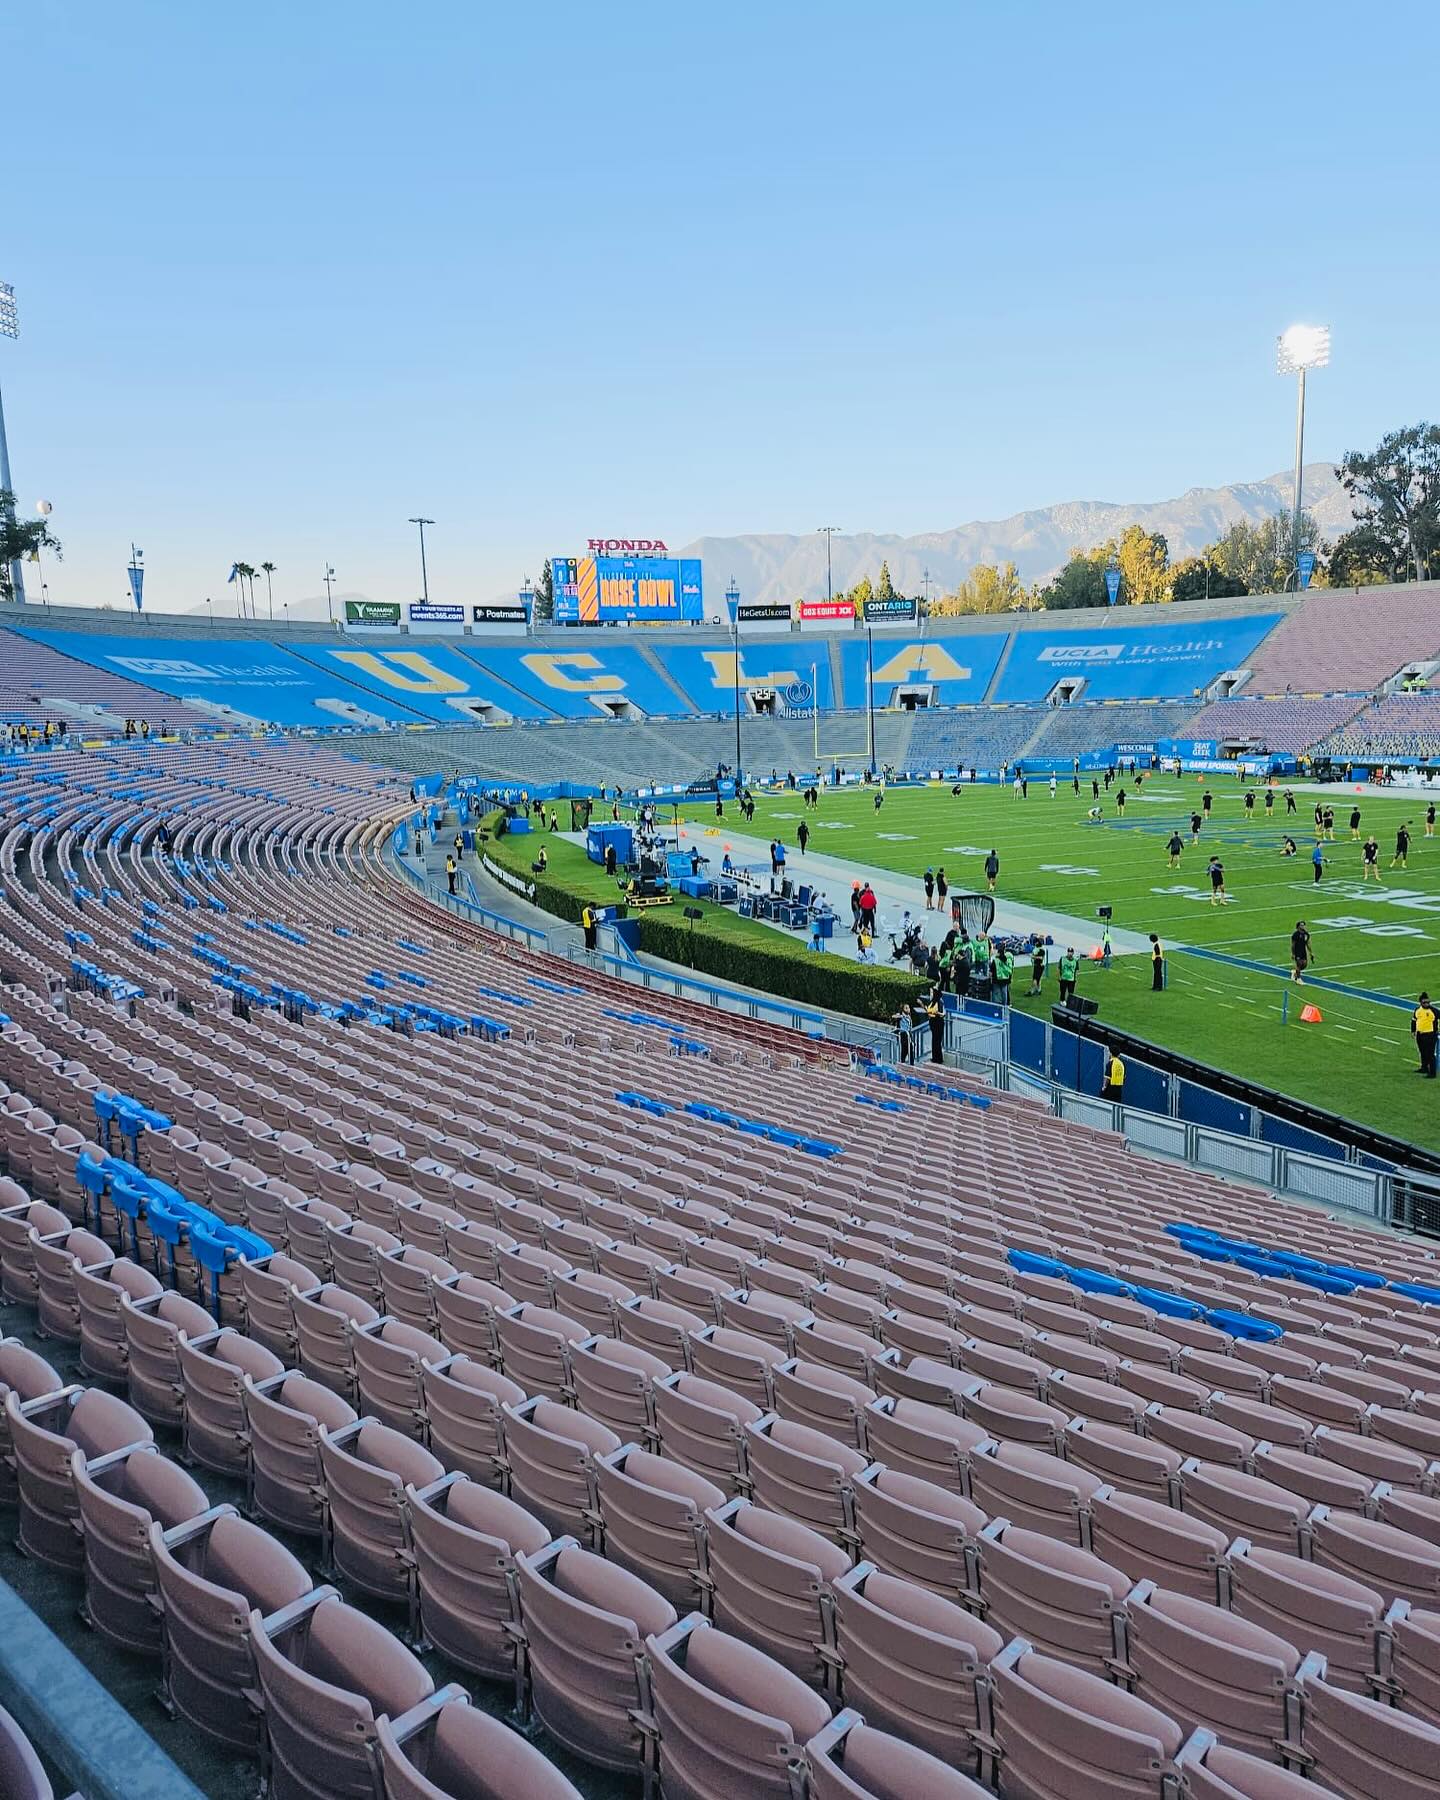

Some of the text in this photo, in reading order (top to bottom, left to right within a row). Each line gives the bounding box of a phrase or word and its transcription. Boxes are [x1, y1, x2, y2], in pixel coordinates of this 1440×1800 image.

[587, 539, 668, 550] HONDA
[600, 579, 677, 607] ROSE BOWL
[411, 612, 463, 620] events365.com
[486, 609, 526, 619] Postmates
[739, 609, 790, 617] HeGetsUs.com
[1052, 640, 1224, 658] UCLA Health
[779, 706, 819, 719] Allstate
[1118, 744, 1147, 752] WESCOM
